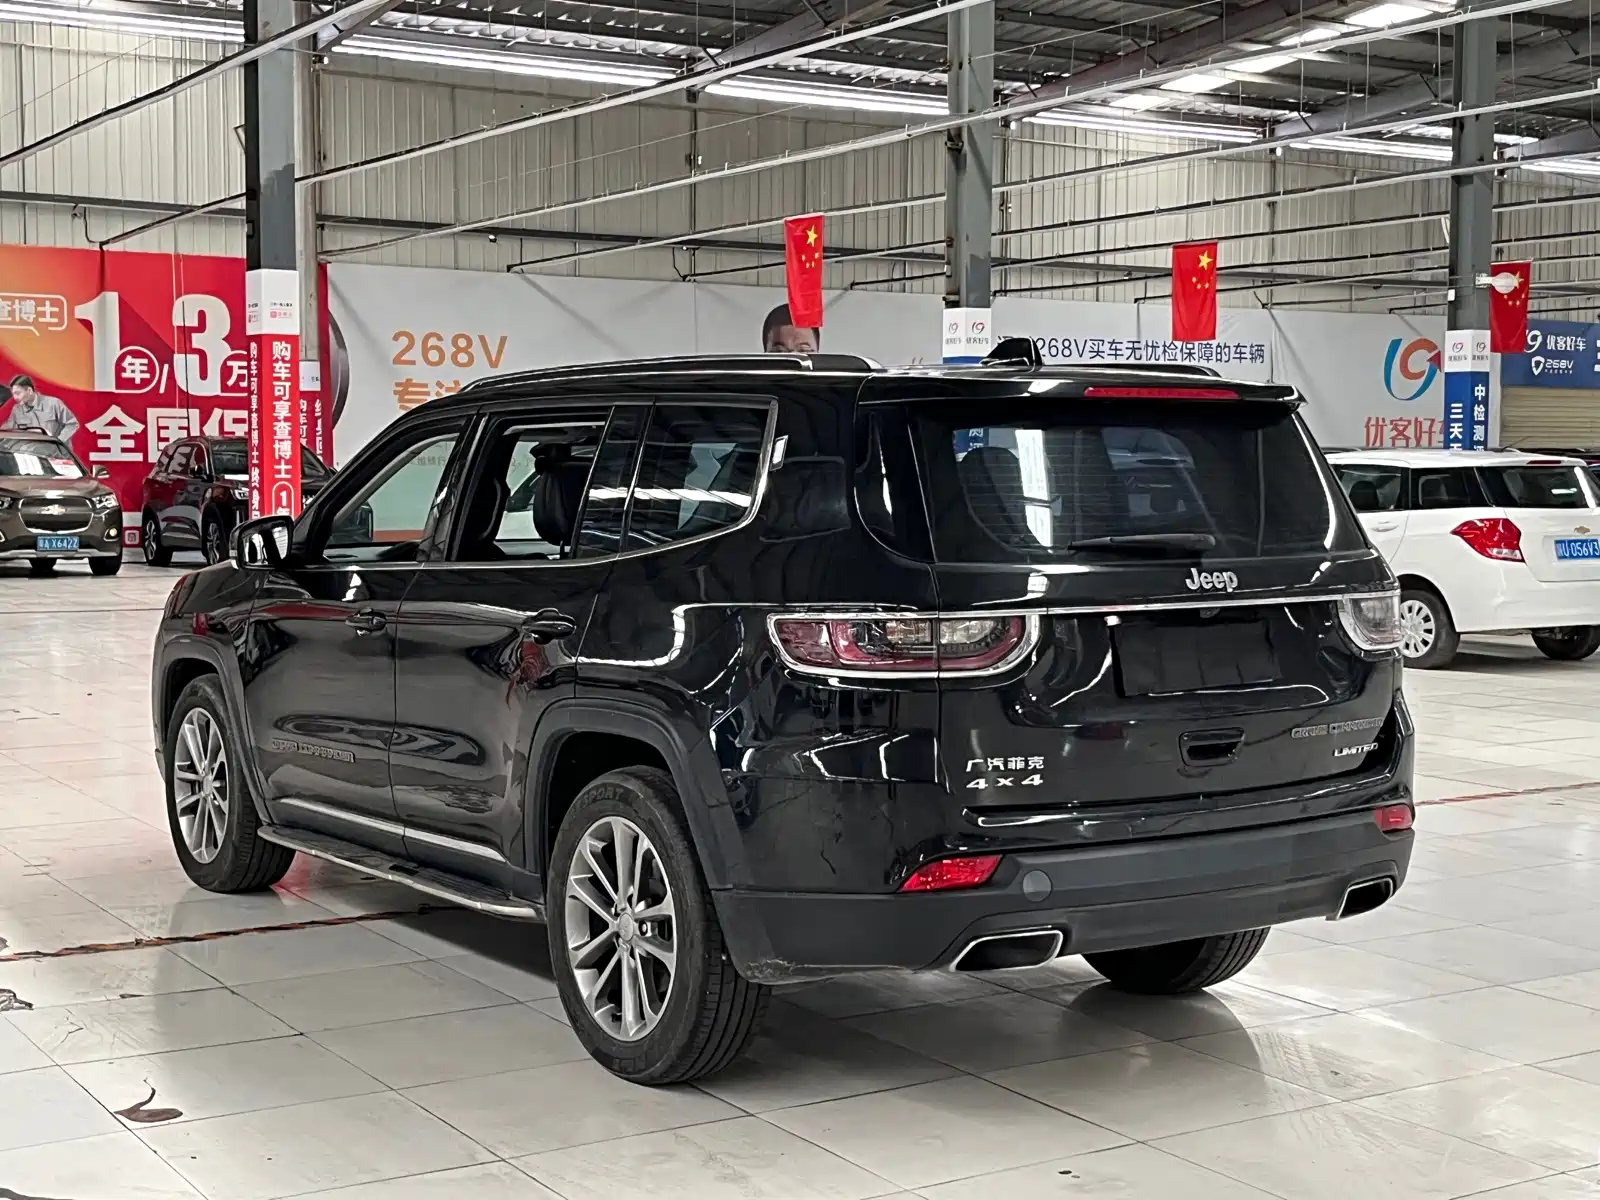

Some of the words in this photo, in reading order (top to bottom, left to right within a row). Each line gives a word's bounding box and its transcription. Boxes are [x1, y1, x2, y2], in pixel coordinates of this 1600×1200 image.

[391, 330, 508, 369] 268V
[997, 335, 1266, 364] 268V买车无忧检保障的车辆
[1546, 334, 1587, 352] 优客好车
[1545, 358, 1574, 369] 268V
[272, 341, 293, 479] 购车可享查博士
[1185, 567, 1239, 592] Jeep
[1333, 742, 1379, 757] LIMITED
[965, 755, 1045, 772] 广汽菲克
